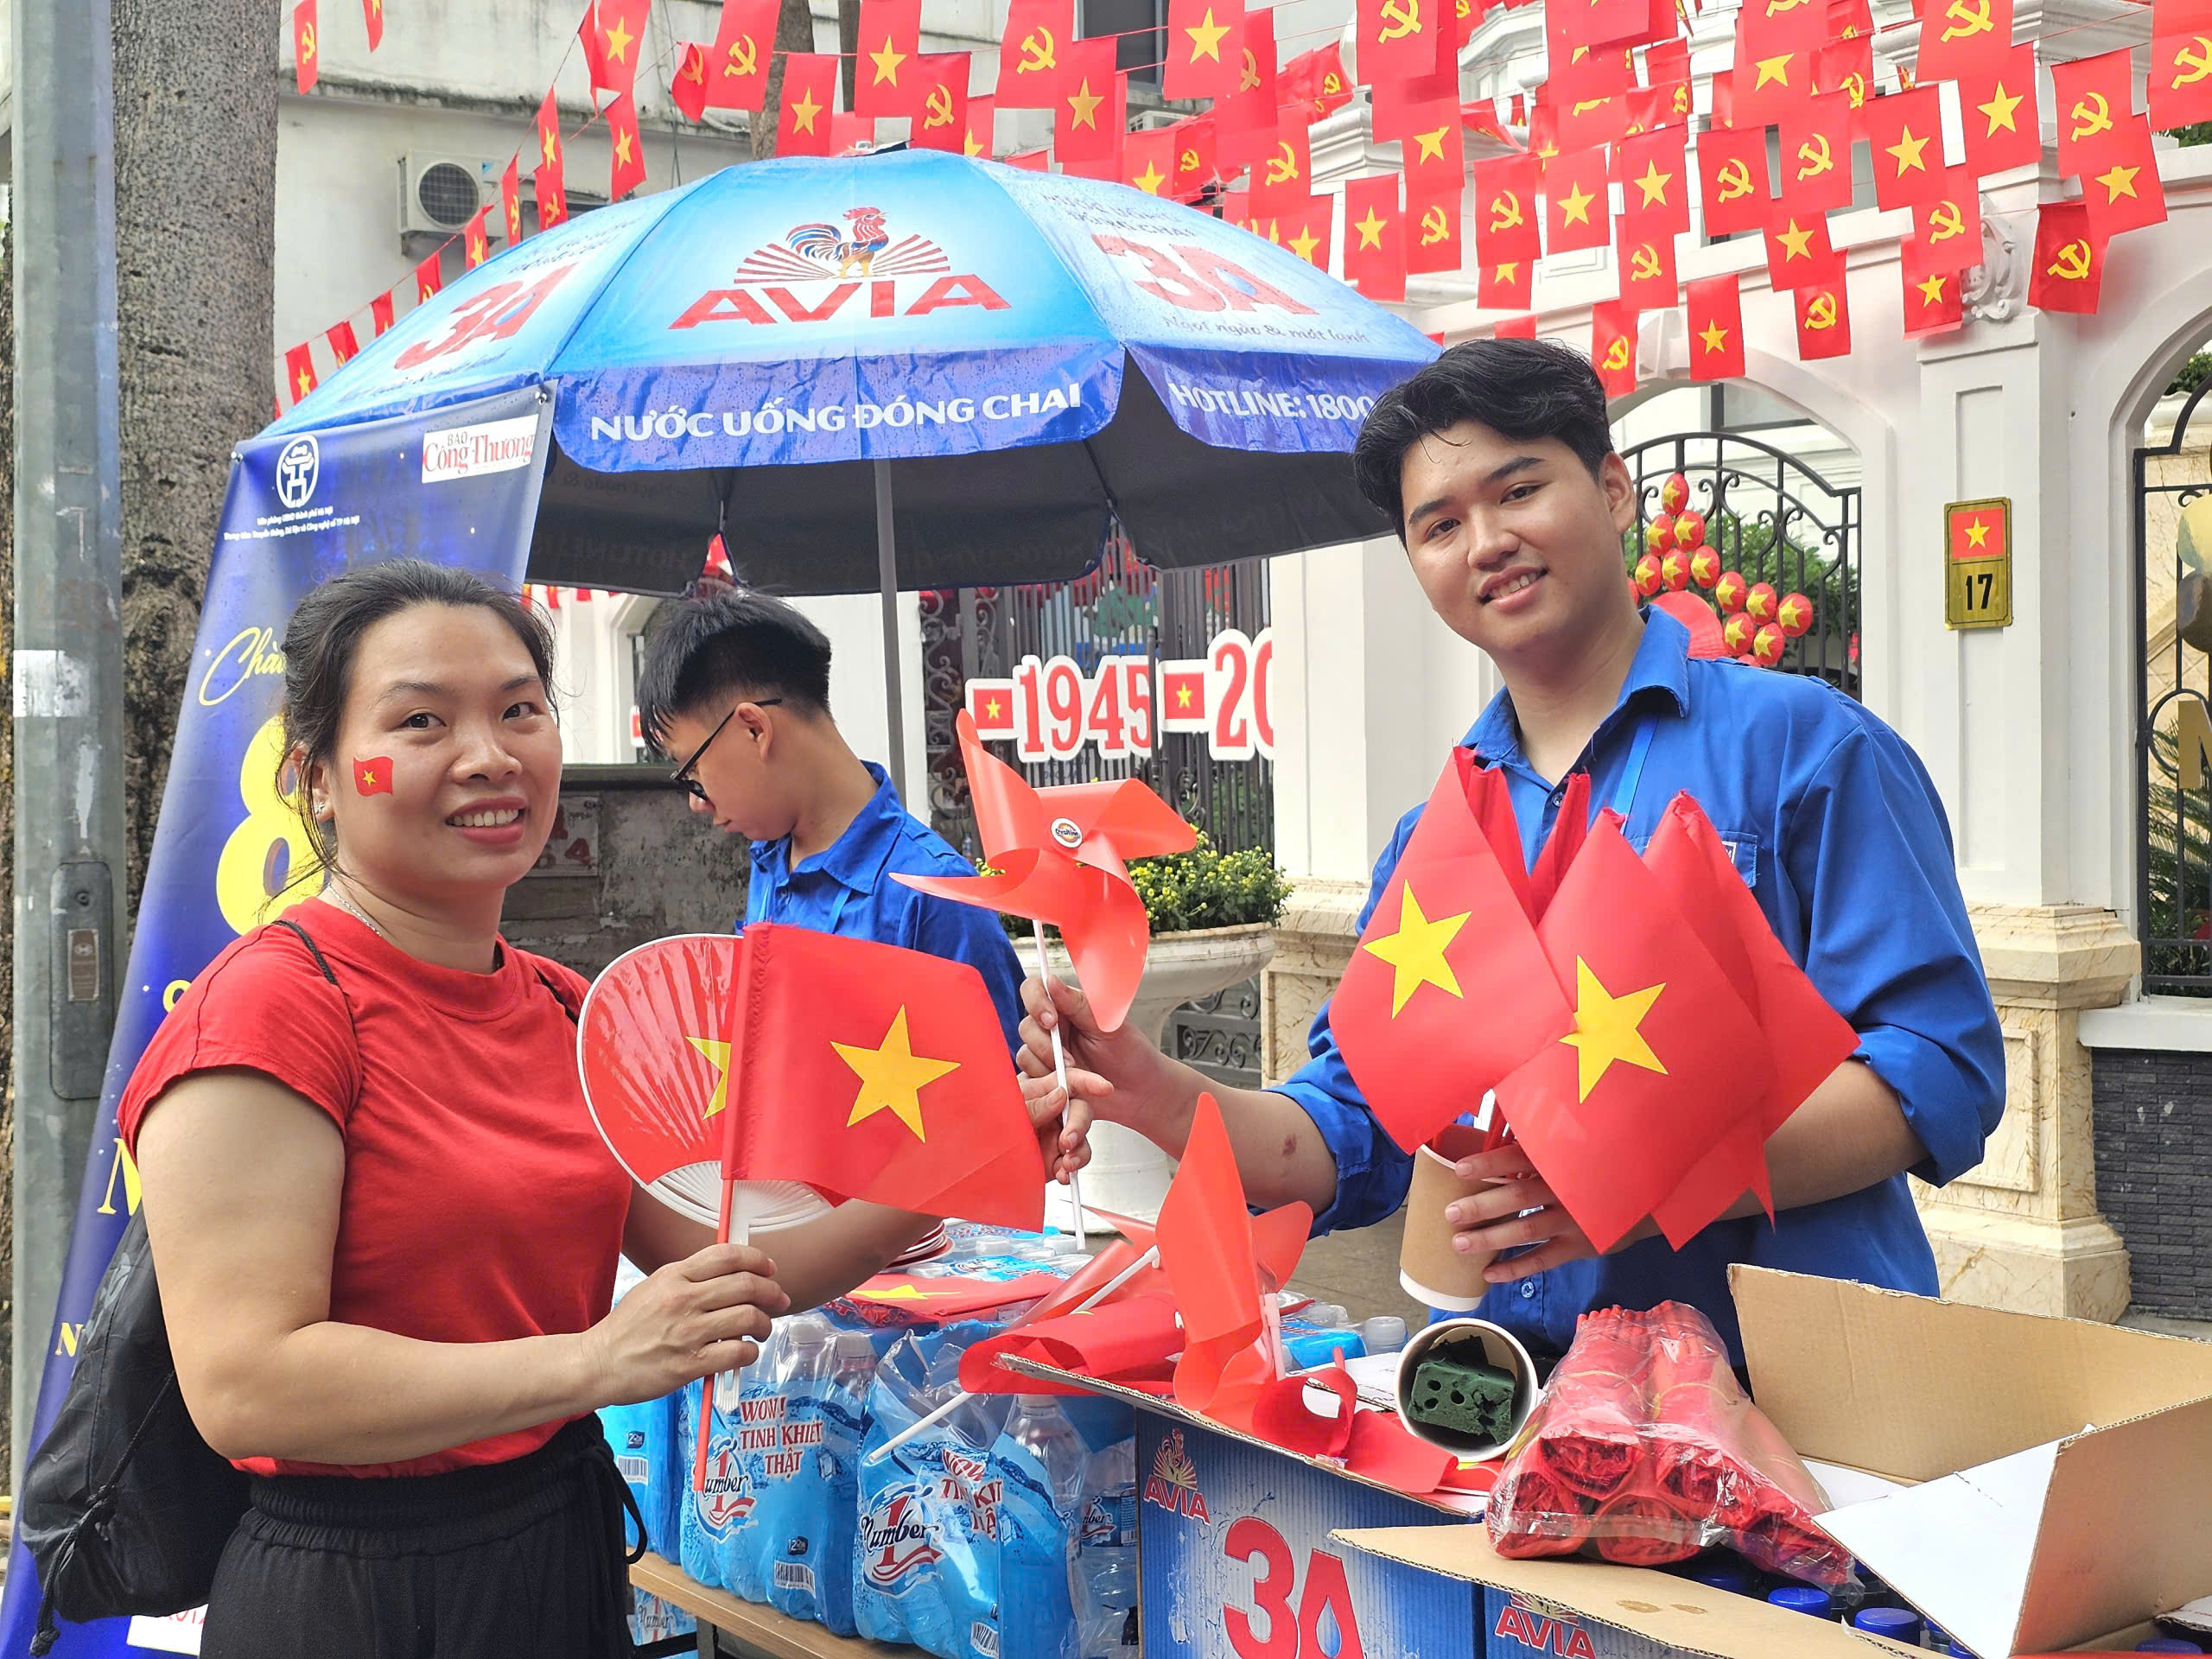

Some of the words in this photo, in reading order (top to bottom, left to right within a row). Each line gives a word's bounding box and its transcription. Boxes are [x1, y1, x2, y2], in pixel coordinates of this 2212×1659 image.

[668, 275, 1011, 330] AVIA
[591, 405, 715, 441] NƯỚC
[725, 397, 845, 435] UỐNG
[851, 397, 974, 429] ĐÓNG
[978, 382, 1081, 421] CHAI
[1168, 383, 1307, 419] HOTLINE:
[1966, 573, 1993, 611] 17
[1020, 664, 1152, 753] 1945
[740, 1427, 777, 1450] TINH
[765, 1446, 804, 1479] THẬT
[693, 1462, 749, 1498] umber
[1143, 1474, 1211, 1526] AVIA
[861, 1509, 940, 1553] Number
[1224, 1516, 1365, 1658] 3A
[1494, 1605, 1597, 1658] AVIA
